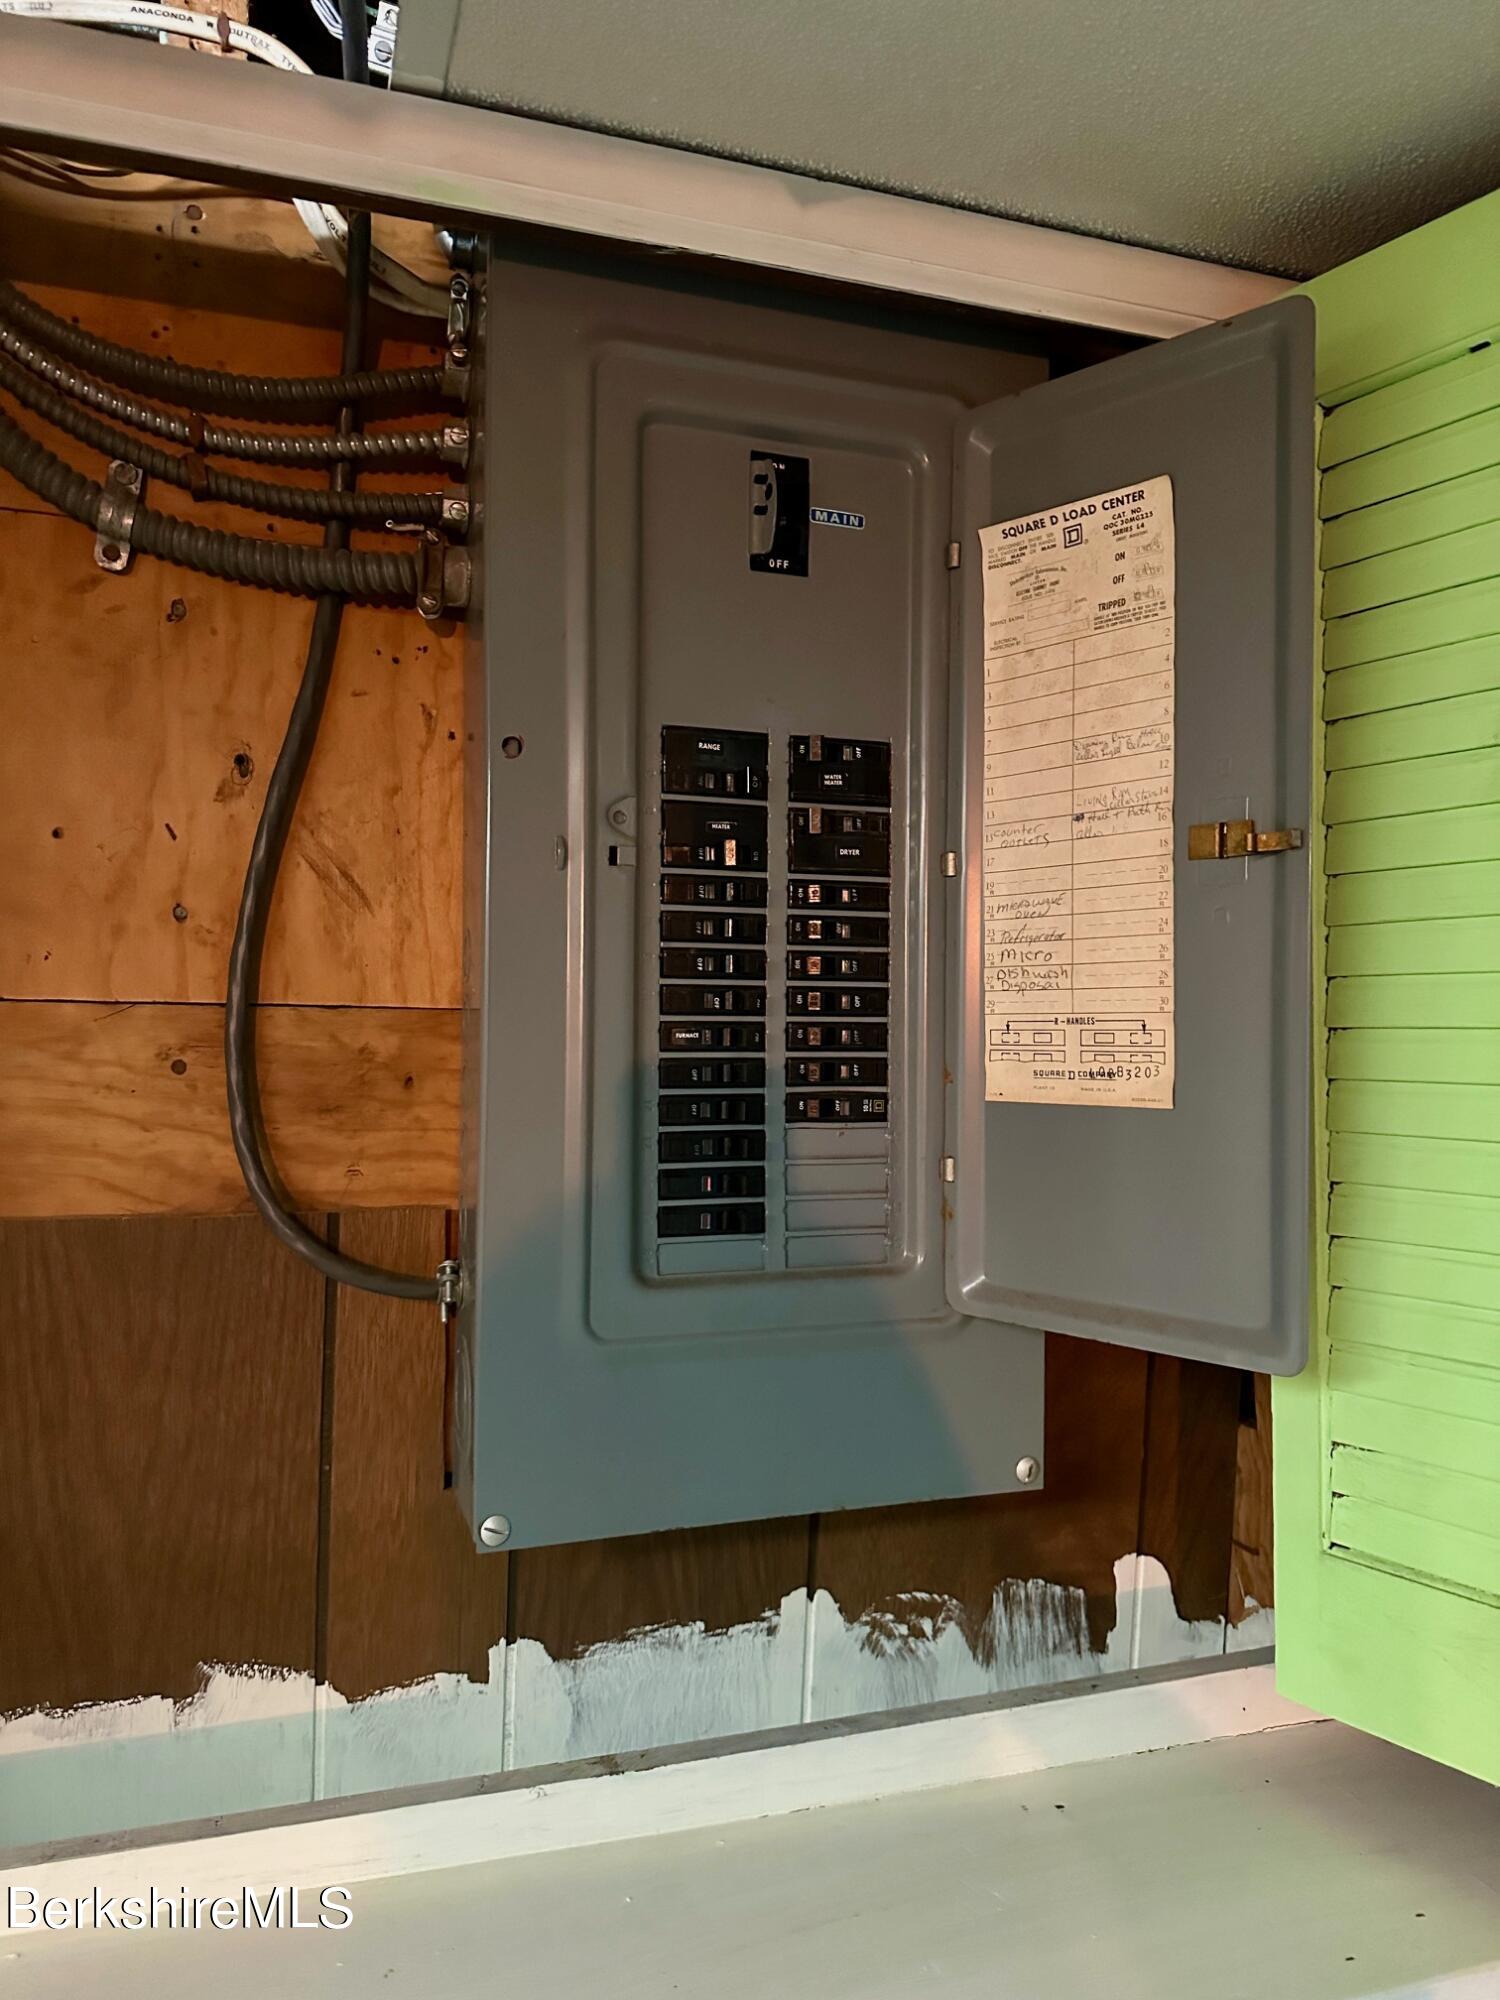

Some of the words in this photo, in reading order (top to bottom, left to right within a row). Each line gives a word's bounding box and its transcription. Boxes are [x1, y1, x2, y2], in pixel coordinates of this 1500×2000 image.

[130, 6, 194, 23] ANACONDA
[815, 510, 859, 527] MAIN
[1001, 517, 1047, 539] SQUARE
[1050, 514, 1059, 526] D
[1063, 504, 1097, 522] LOAD
[1101, 489, 1145, 511] CENTER
[1112, 526, 1133, 537] SERIES
[1115, 551, 1126, 561] ON
[768, 558, 789, 569] OFF
[1113, 574, 1125, 584] OFF
[1098, 598, 1126, 612] TRIPPED
[1160, 732, 1170, 742] 10
[698, 742, 721, 751] RANGE
[799, 744, 805, 754] ON
[1159, 760, 1169, 769] 12
[1159, 786, 1169, 795] 14
[1157, 812, 1167, 821] 16
[1159, 838, 1169, 847] 18
[986, 857, 995, 867] 17
[1158, 864, 1168, 874] 20
[986, 881, 995, 890] 19
[798, 888, 804, 898] ON
[1158, 891, 1168, 900] 22
[986, 905, 994, 914] 21
[1158, 917, 1168, 927] 24
[987, 929, 995, 937] 23
[1158, 944, 1168, 953] 26
[987, 952, 995, 961] 25
[1158, 970, 1168, 979] 28
[986, 976, 994, 984] 27
[796, 995, 803, 1004] ON
[986, 1000, 995, 1008] 29
[1159, 996, 1169, 1005] 30
[797, 1029, 803, 1039] ON
[800, 1064, 805, 1074] ON
[1033, 1069, 1066, 1077] SQUARE
[1068, 1070, 1076, 1081] D
[799, 1101, 804, 1111] ON
